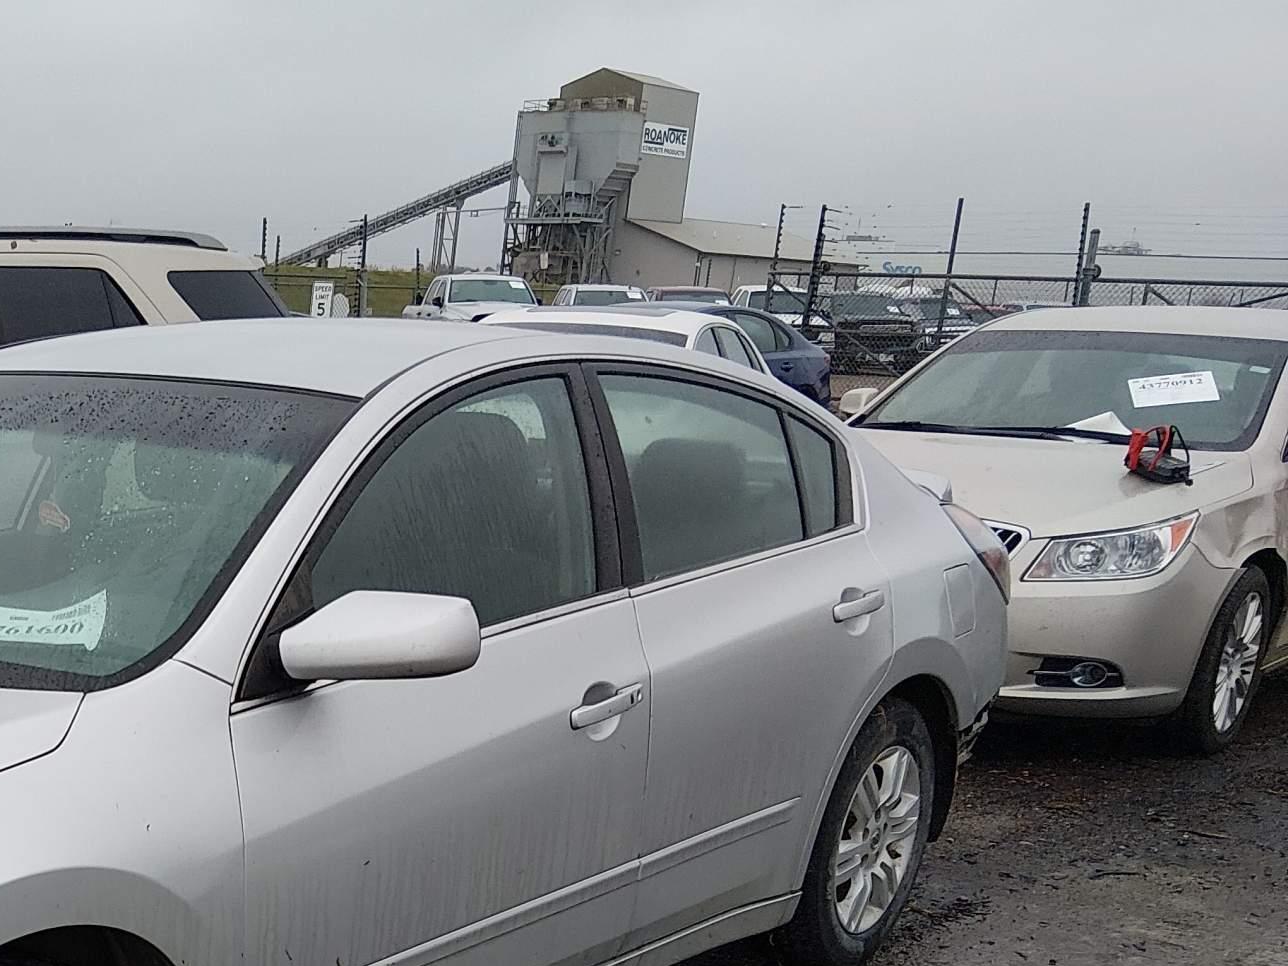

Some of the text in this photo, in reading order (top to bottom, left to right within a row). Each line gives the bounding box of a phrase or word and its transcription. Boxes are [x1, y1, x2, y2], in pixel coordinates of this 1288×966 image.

[644, 127, 688, 146] ROANOKE
[317, 302, 325, 316] 5
[1139, 378, 1203, 390] 43770912
